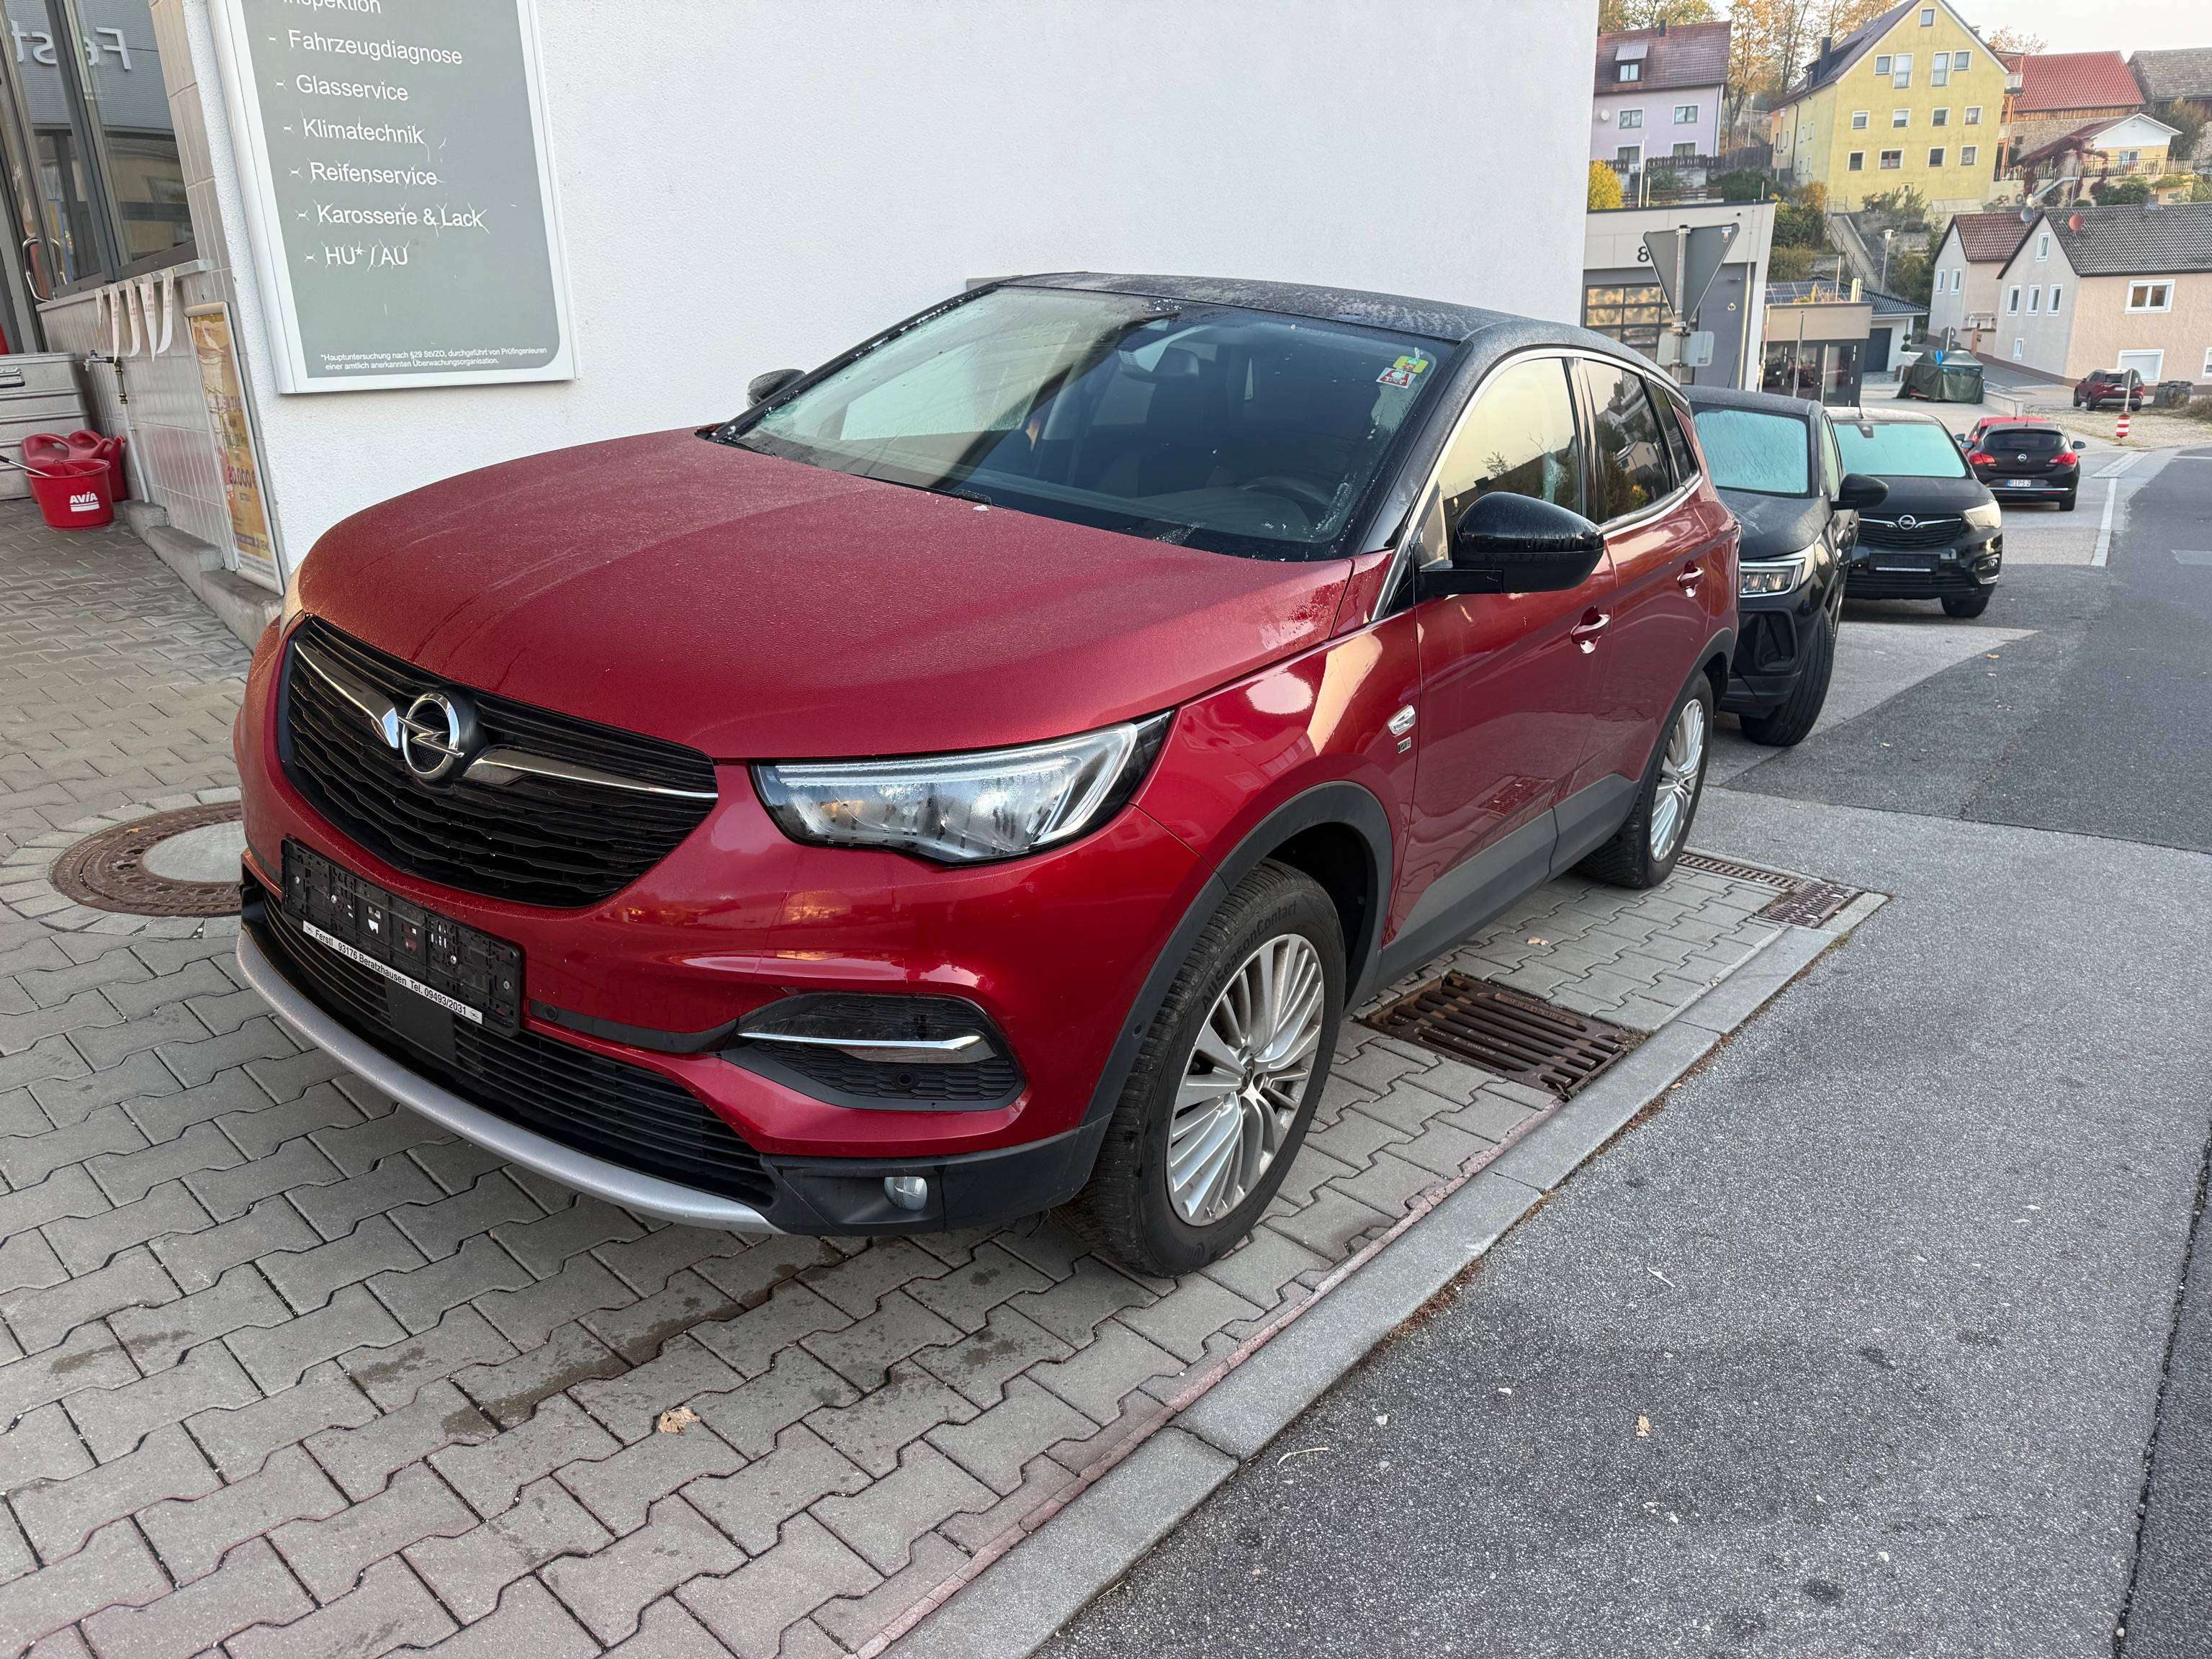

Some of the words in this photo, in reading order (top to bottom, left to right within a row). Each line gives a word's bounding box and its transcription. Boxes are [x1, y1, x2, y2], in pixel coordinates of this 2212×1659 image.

[288, 29, 463, 65] Fahrzeugdiagnose
[296, 74, 409, 101] Glasservice
[303, 118, 425, 144] Klimatechnik
[310, 161, 438, 186] Reifenservice
[317, 204, 418, 225] Karosserie
[423, 208, 436, 225] &
[441, 207, 484, 228] Lack
[410, 351, 422, 359] §29
[448, 349, 488, 358] durchgeführt
[501, 347, 547, 356] Prüfingenieuren
[413, 357, 499, 367] Überwachungsorganisation.
[70, 491, 98, 504] AVIA
[315, 930, 333, 948] Ferstl
[338, 943, 358, 960] 93176
[359, 951, 407, 986] Beratzhausen
[410, 979, 423, 994] Tel.
[424, 989, 467, 1015] 09493/2031
